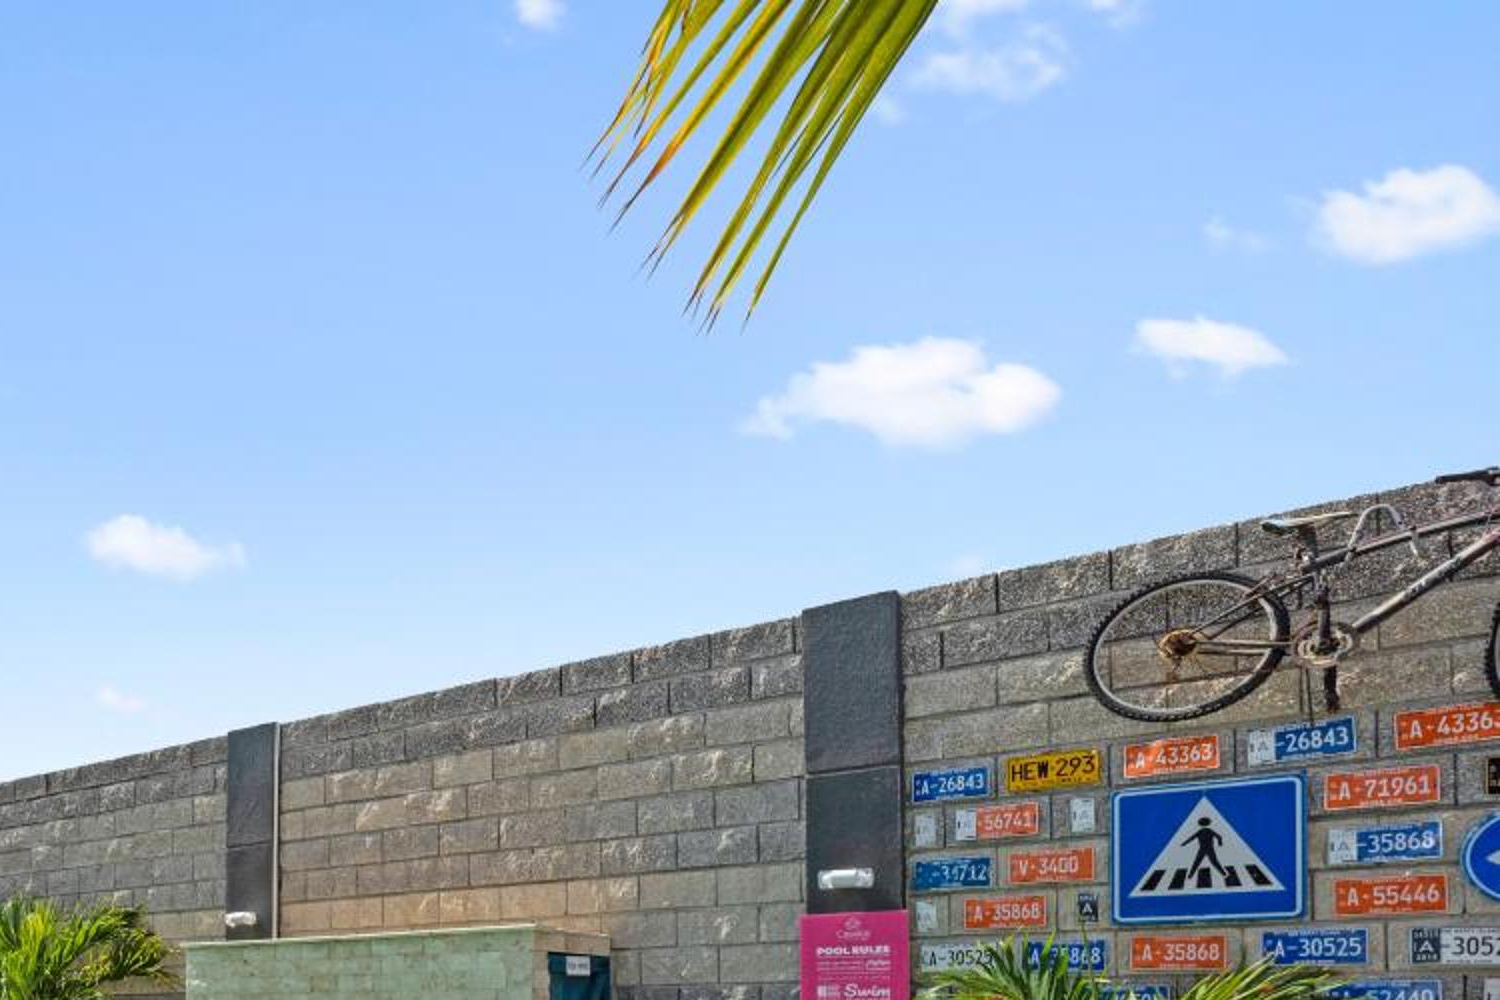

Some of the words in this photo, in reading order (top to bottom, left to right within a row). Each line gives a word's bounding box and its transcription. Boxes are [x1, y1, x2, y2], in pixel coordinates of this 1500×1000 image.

[1410, 711, 1500, 738] A-4336
[1011, 759, 1049, 782] HEW
[1055, 755, 1095, 777] 293
[816, 946, 851, 956] POOL
[1274, 937, 1363, 959] A-30525
[843, 983, 891, 998] Swim
